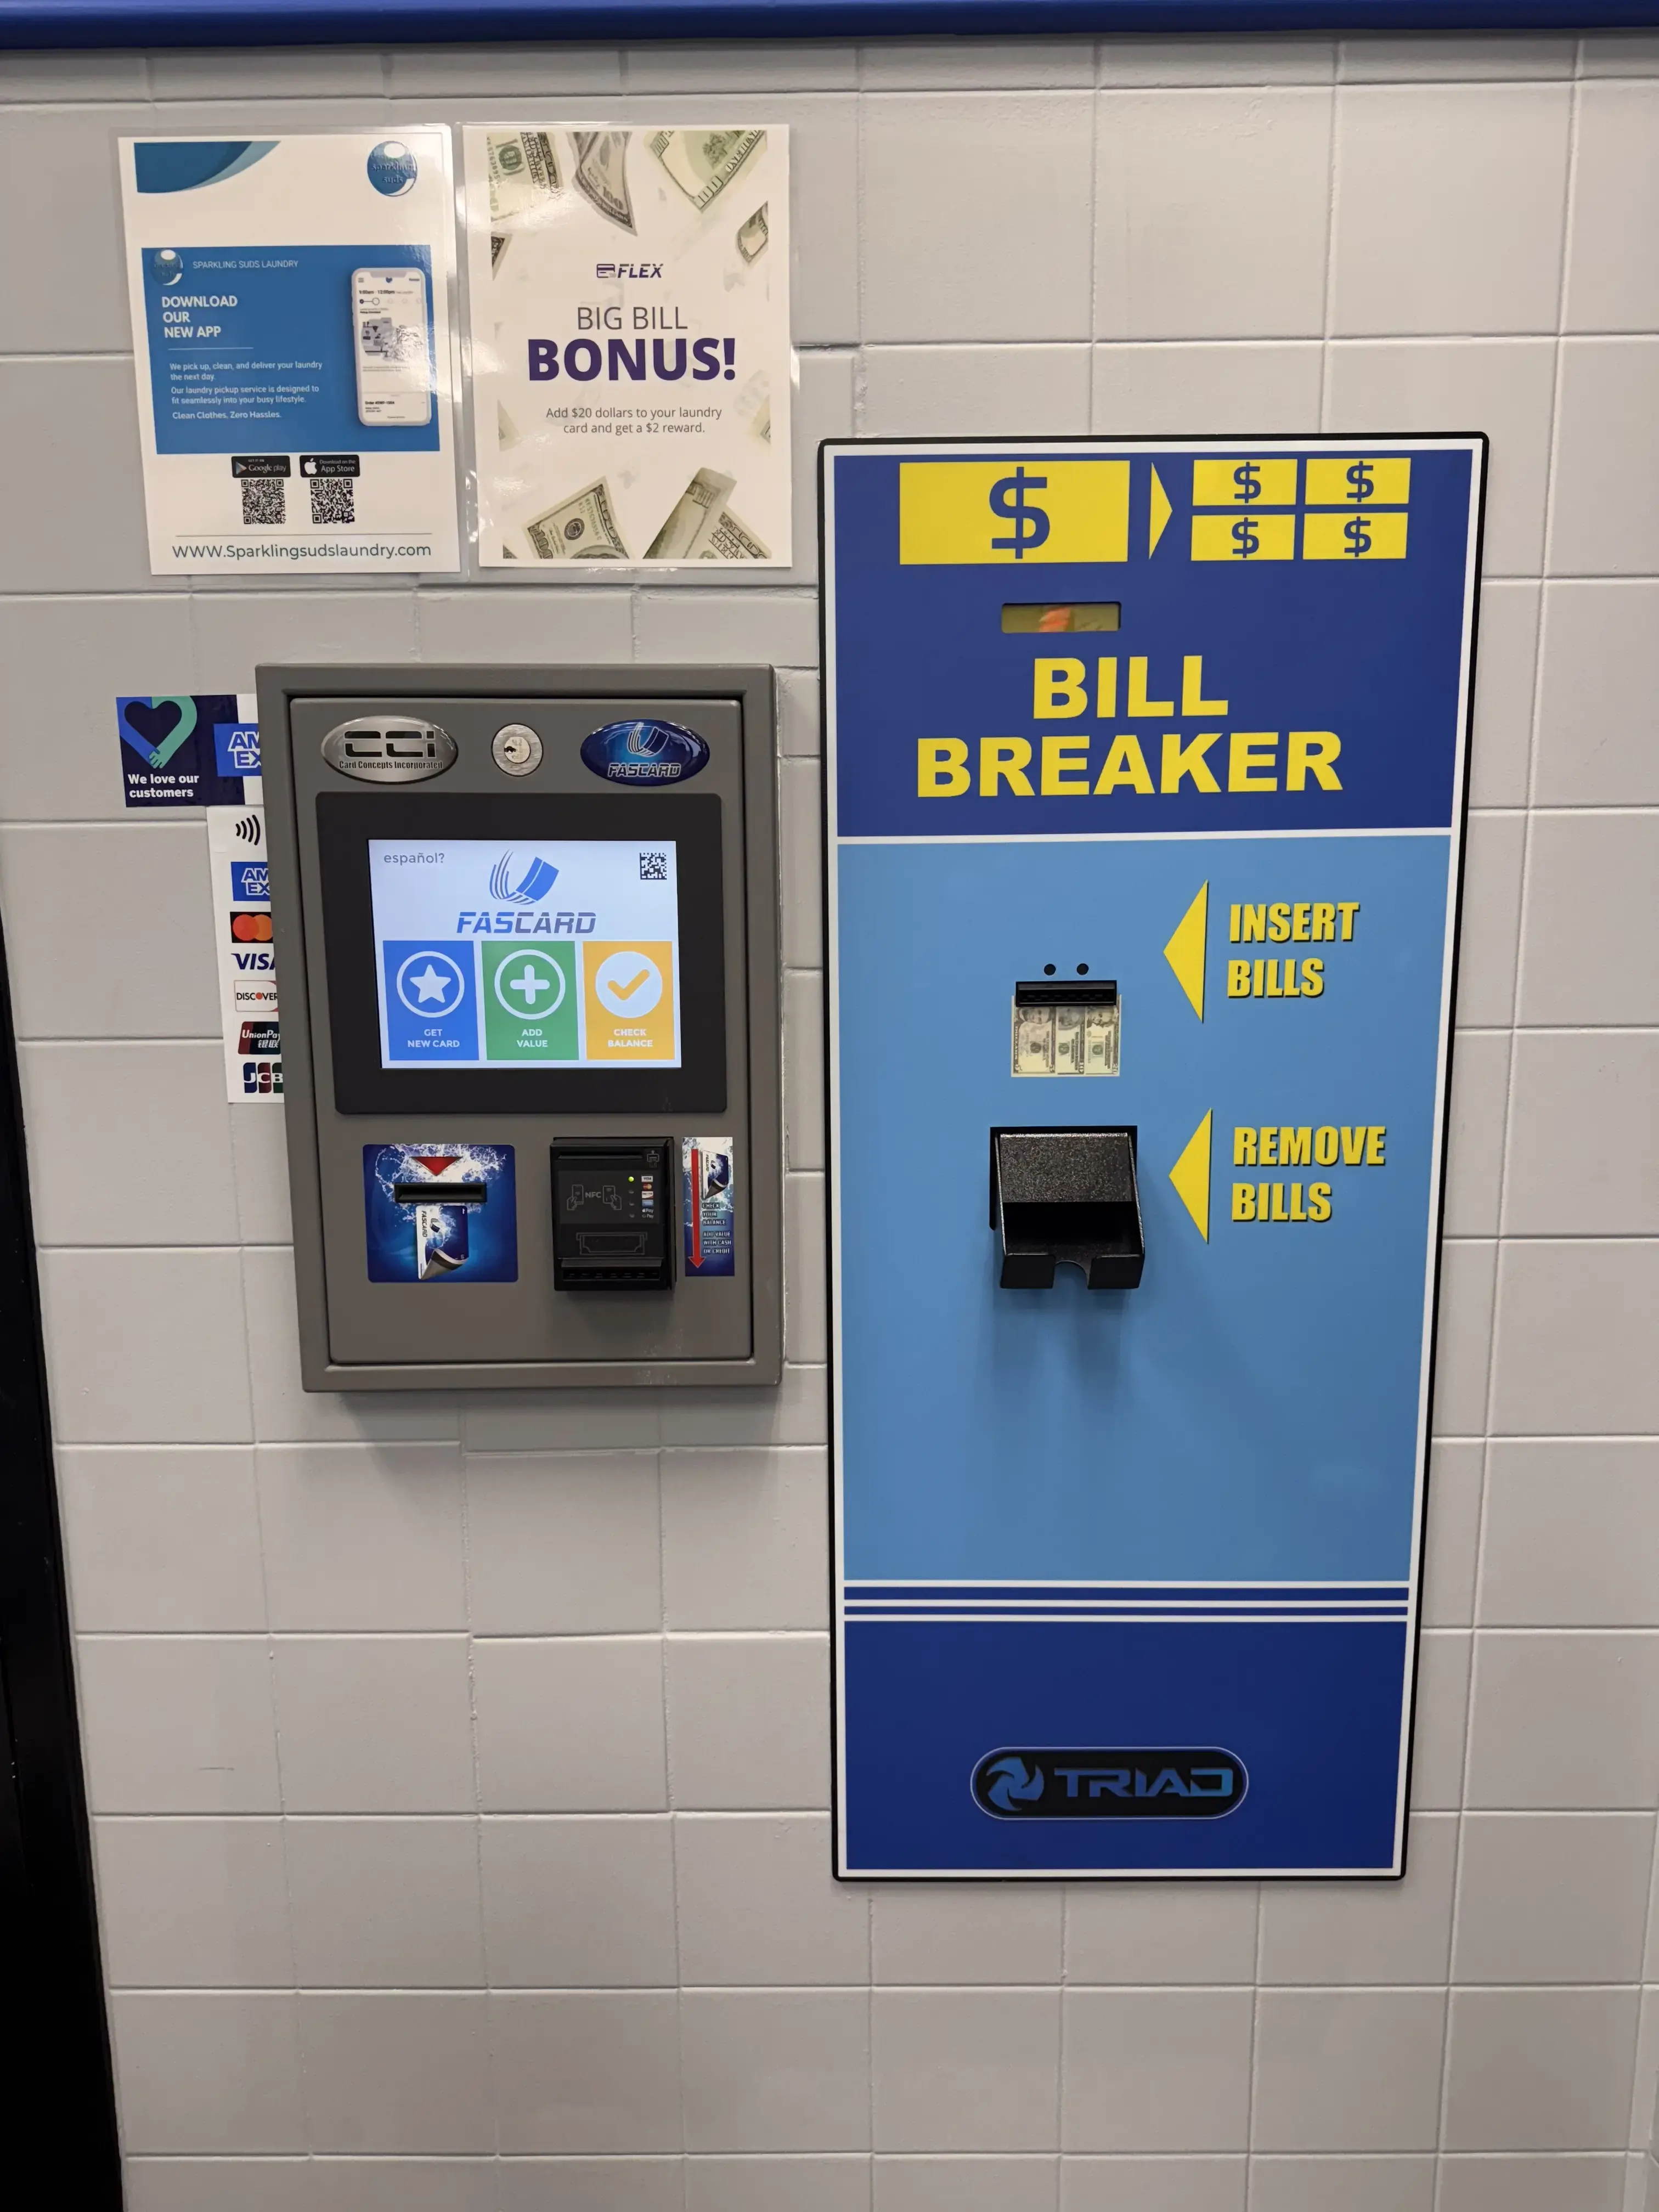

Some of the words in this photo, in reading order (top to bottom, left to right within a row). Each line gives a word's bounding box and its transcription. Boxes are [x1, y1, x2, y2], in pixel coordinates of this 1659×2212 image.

[193, 261, 237, 269] SPARKLING
[262, 259, 298, 268] LAUNDRY
[618, 263, 663, 278] FLEX
[162, 295, 238, 308] DOWNLOAD
[162, 312, 190, 323] OUR
[578, 307, 622, 330] BIG
[633, 306, 688, 330] BILL
[164, 326, 193, 338] NEW
[196, 326, 222, 337] APP
[183, 363, 198, 371] pick
[213, 362, 234, 370] clean,
[295, 361, 323, 370] laundry
[528, 338, 736, 381] BONUS!
[185, 386, 212, 395] laundry
[215, 386, 239, 395] pickup
[276, 385, 310, 393] designed
[181, 396, 221, 405] seamlessly
[257, 396, 274, 404] busy
[275, 396, 306, 404] lifestyle.
[196, 411, 228, 420] Clothes,
[546, 408, 568, 417] Add
[572, 408, 591, 418] $20
[595, 408, 633, 417] dollars
[636, 409, 647, 417] to
[650, 409, 676, 420] your
[679, 407, 721, 420] laundry
[563, 423, 587, 433] card
[591, 423, 612, 432] and
[616, 424, 633, 435] get
[646, 422, 659, 433] $2
[663, 422, 705, 433] reward.
[249, 464, 272, 473] Google
[172, 544, 431, 560] WWW.Sparklingsudslaundry.com
[1034, 656, 1228, 720] BILL
[358, 761, 392, 769] Concepts
[394, 761, 442, 769] Incorporated
[608, 763, 681, 777] FASCARD
[917, 731, 1343, 798] BREAKER
[128, 774, 147, 784] We
[150, 774, 176, 784] love
[178, 775, 199, 783] our
[129, 788, 194, 798] customers
[383, 851, 445, 866] español?
[456, 911, 596, 934] FASCARD
[1229, 902, 1360, 943] INSERT
[1227, 958, 1325, 998] BILLS
[408, 1040, 431, 1048] NEW
[432, 1040, 460, 1048] CARD
[516, 1040, 548, 1048] VALUE
[607, 1040, 653, 1048] BALANCE
[244, 1073, 283, 1084] JCB
[1234, 1126, 1386, 1166] REMOVE
[1232, 1182, 1332, 1222] BILLS
[1054, 1767, 1233, 1797] TRIAD
